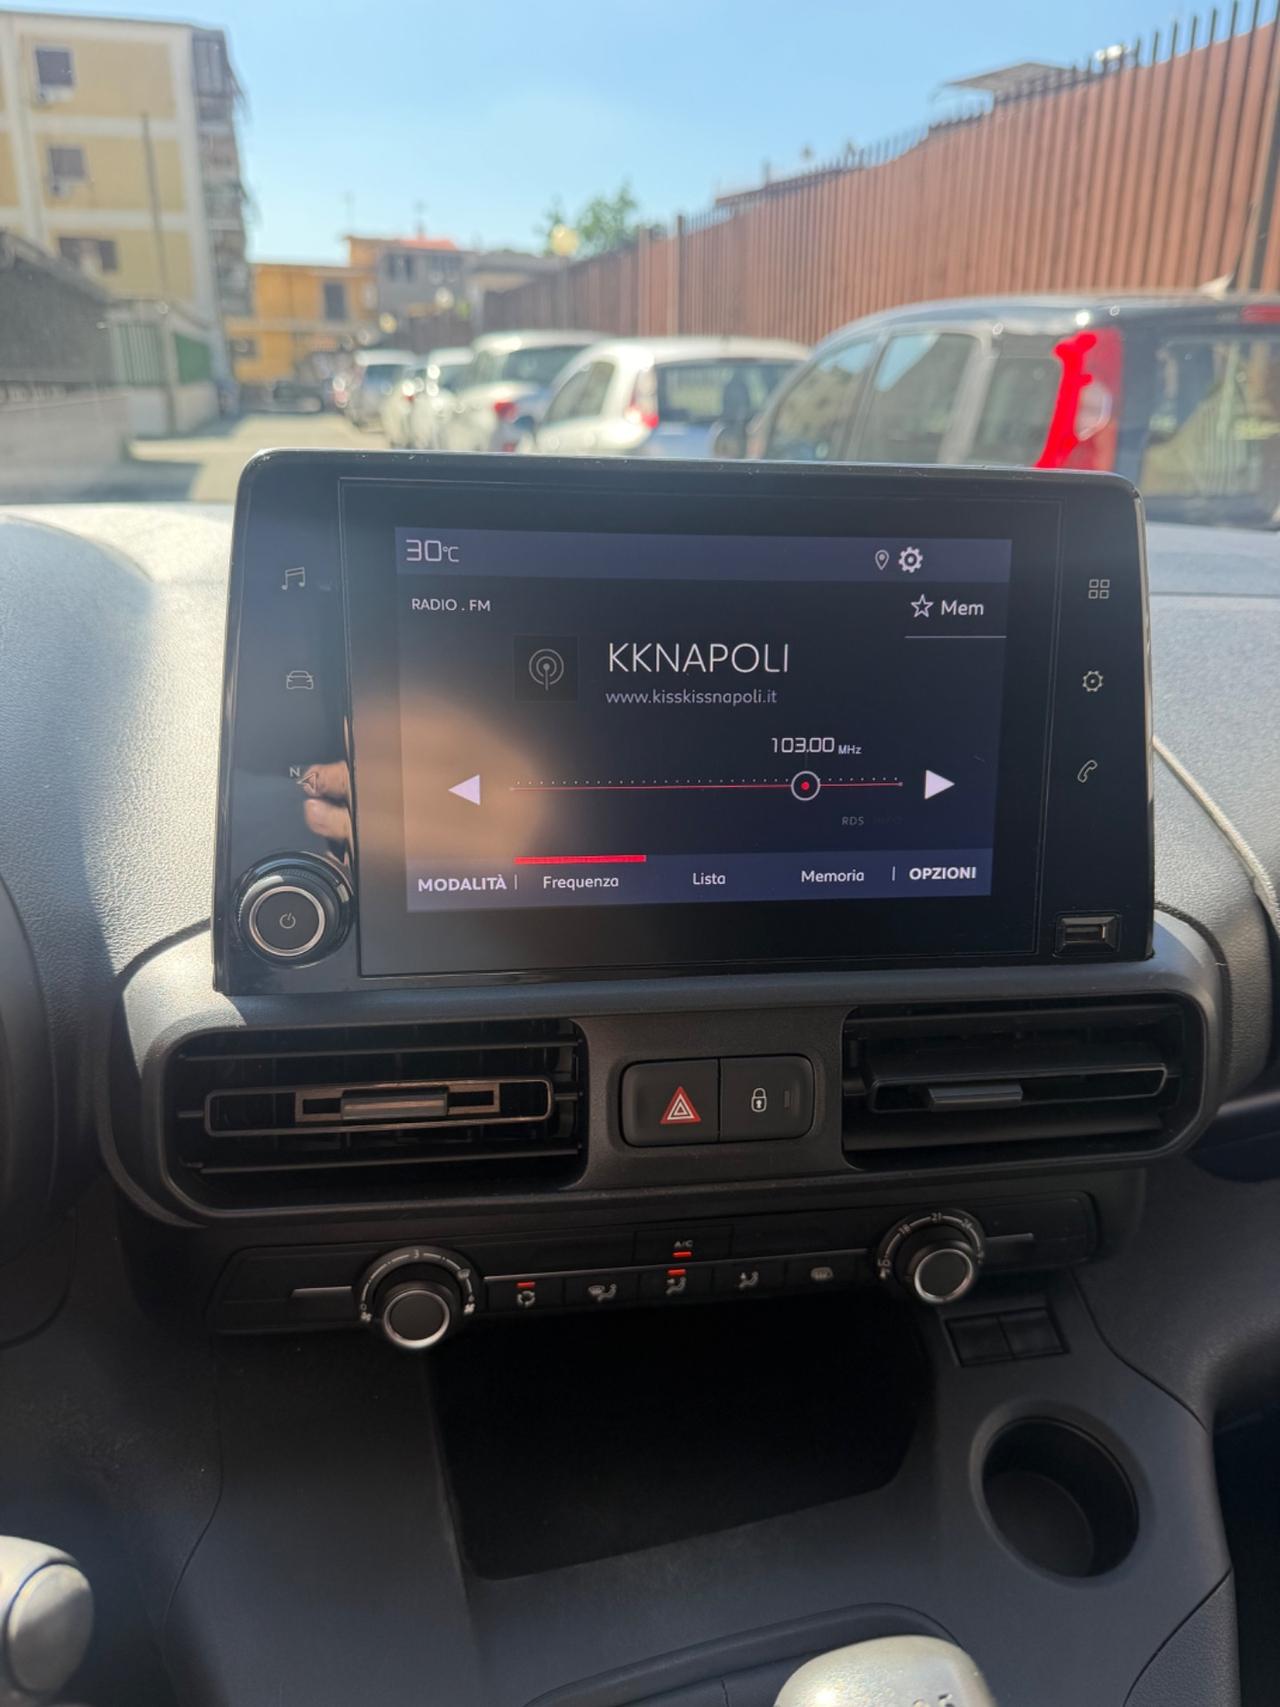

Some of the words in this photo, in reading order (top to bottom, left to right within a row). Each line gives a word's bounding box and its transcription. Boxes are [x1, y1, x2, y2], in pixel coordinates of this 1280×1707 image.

[411, 598, 457, 611] RADIO
[469, 599, 491, 612] FM
[940, 600, 984, 615] Mem
[609, 643, 789, 673] KKNAPOLI
[605, 689, 778, 707] www.kisskissnapoli.it
[771, 737, 835, 753] 103.00
[289, 766, 300, 777] N
[841, 816, 865, 826] RDS
[692, 872, 726, 885] Lista
[800, 868, 865, 883] Memoria
[909, 866, 977, 880] OPZIONI
[417, 874, 507, 892] MODALITÀ
[542, 875, 619, 891] Frequenza
